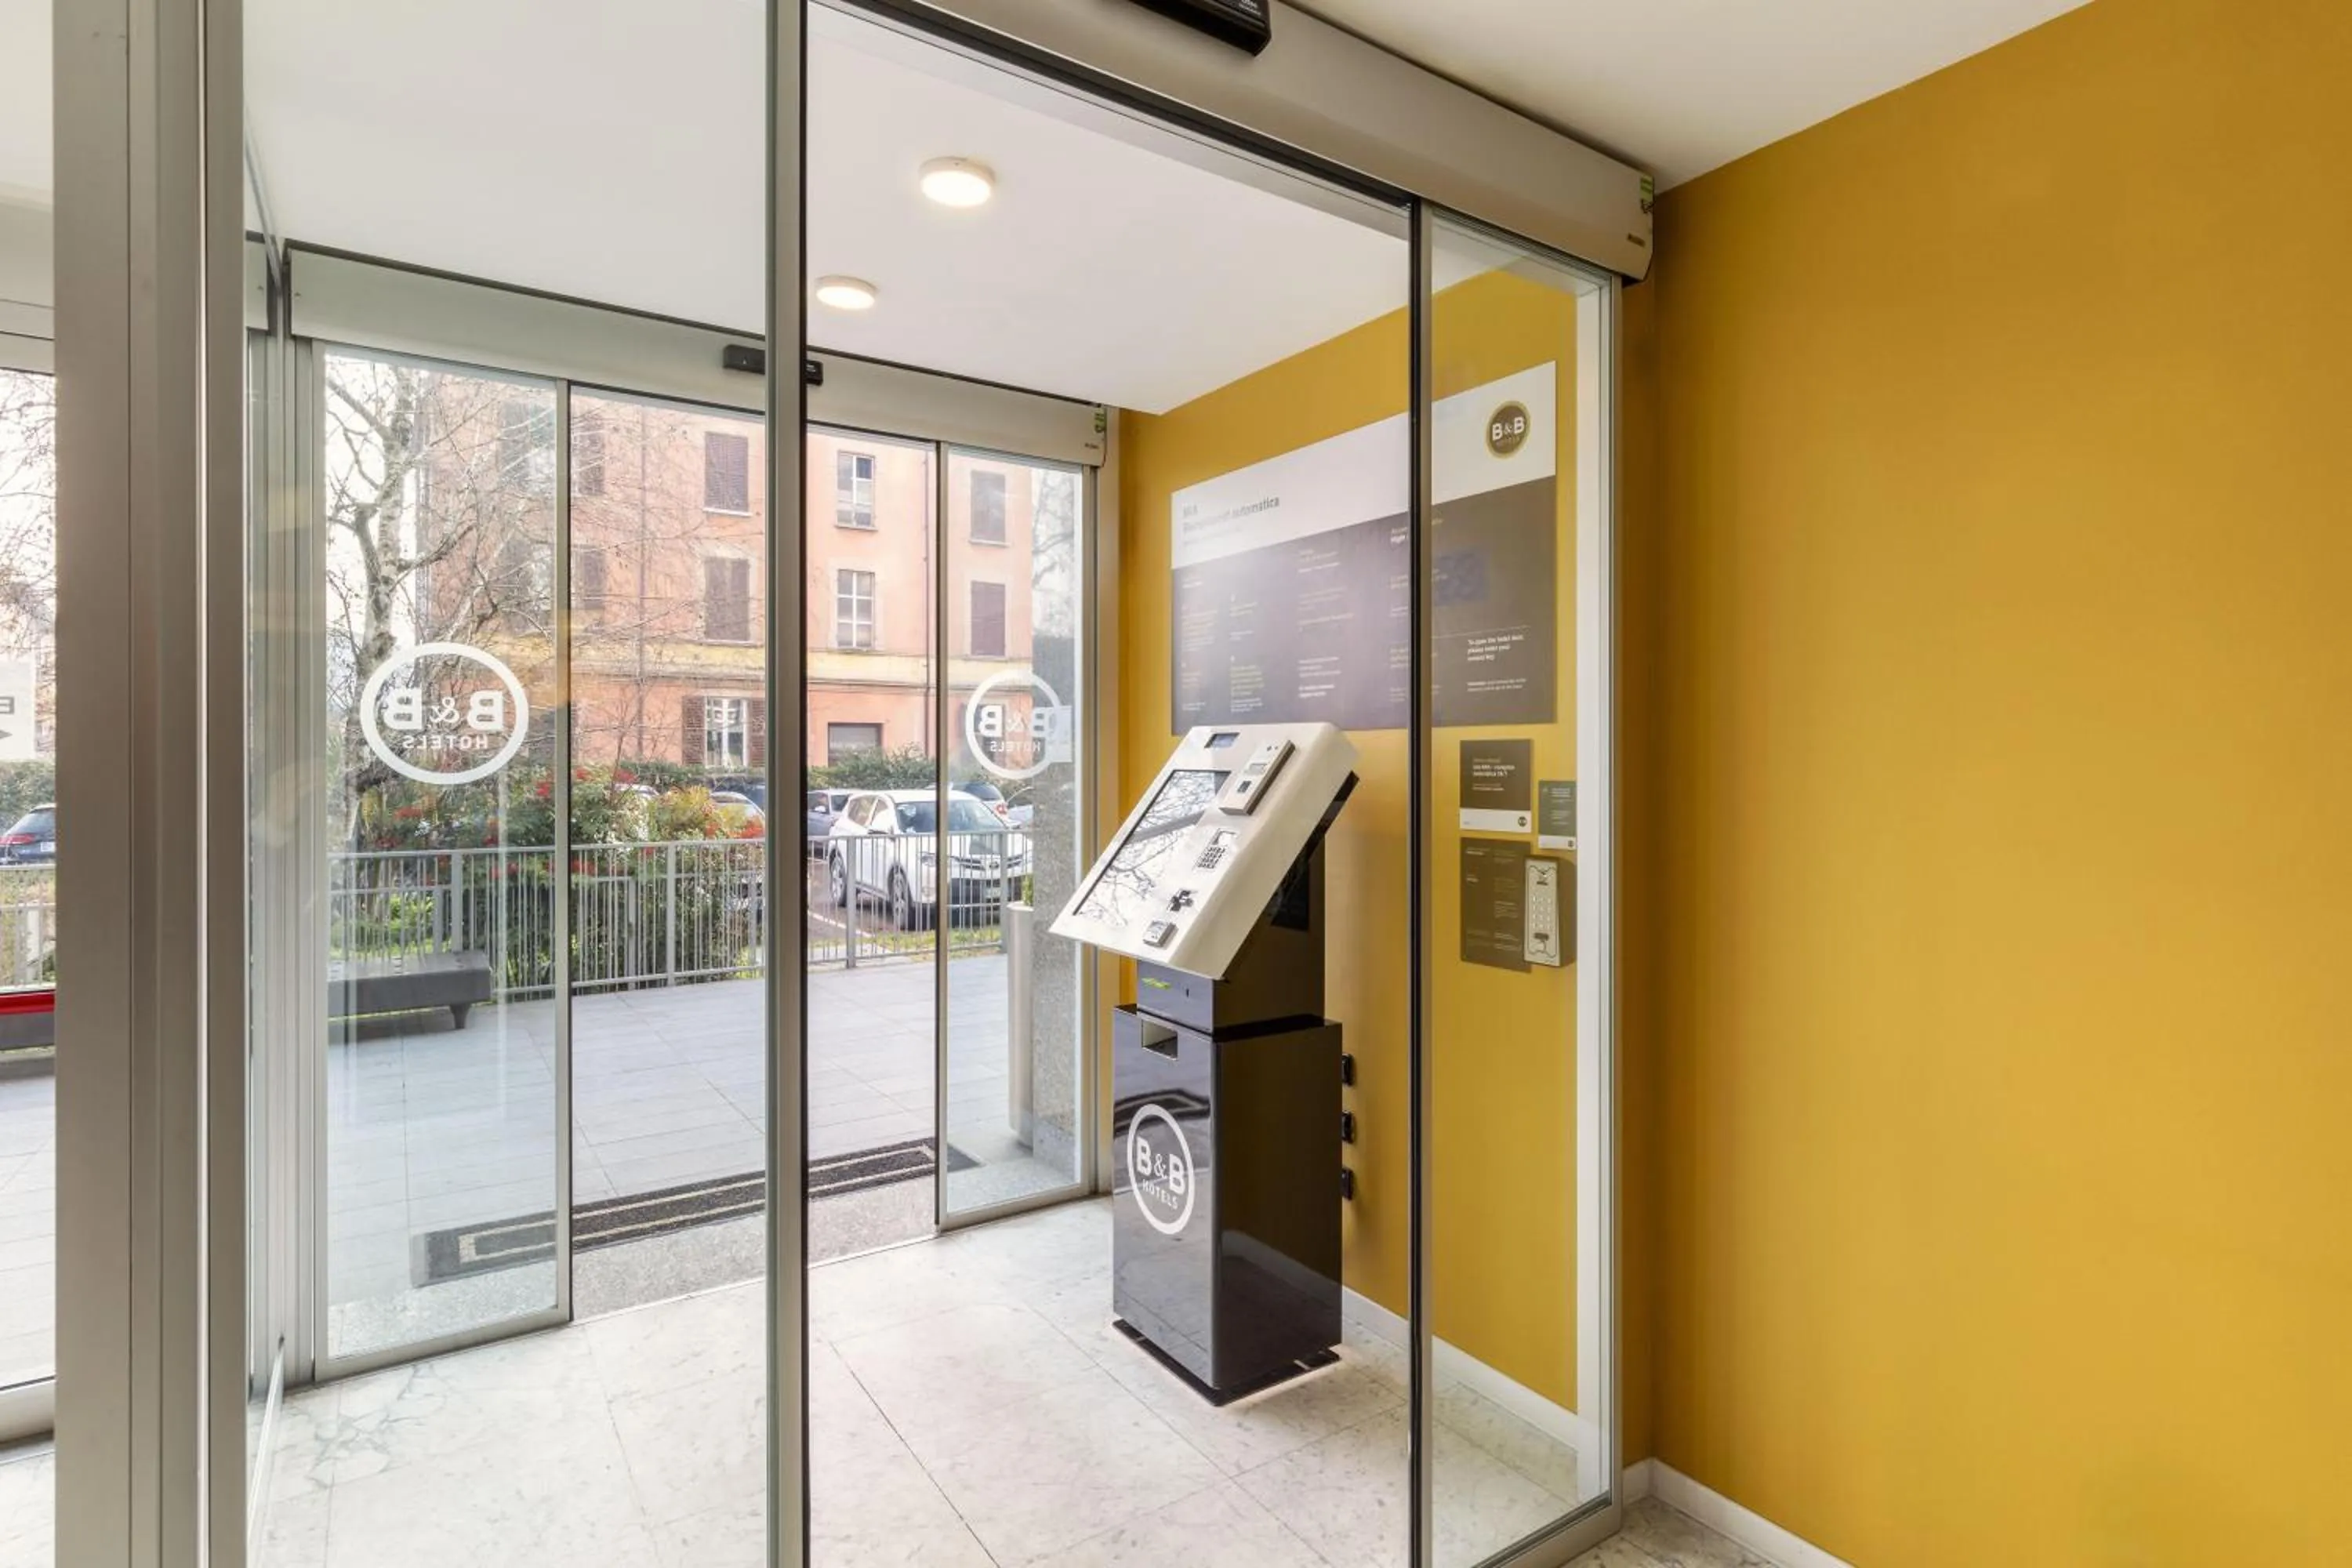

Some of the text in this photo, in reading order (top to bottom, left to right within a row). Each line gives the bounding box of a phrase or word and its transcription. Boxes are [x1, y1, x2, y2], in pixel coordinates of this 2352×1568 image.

[1492, 416, 1525, 441] B&B
[1137, 1137, 1185, 1194] B&B
[1142, 1178, 1178, 1210] HOTELS
